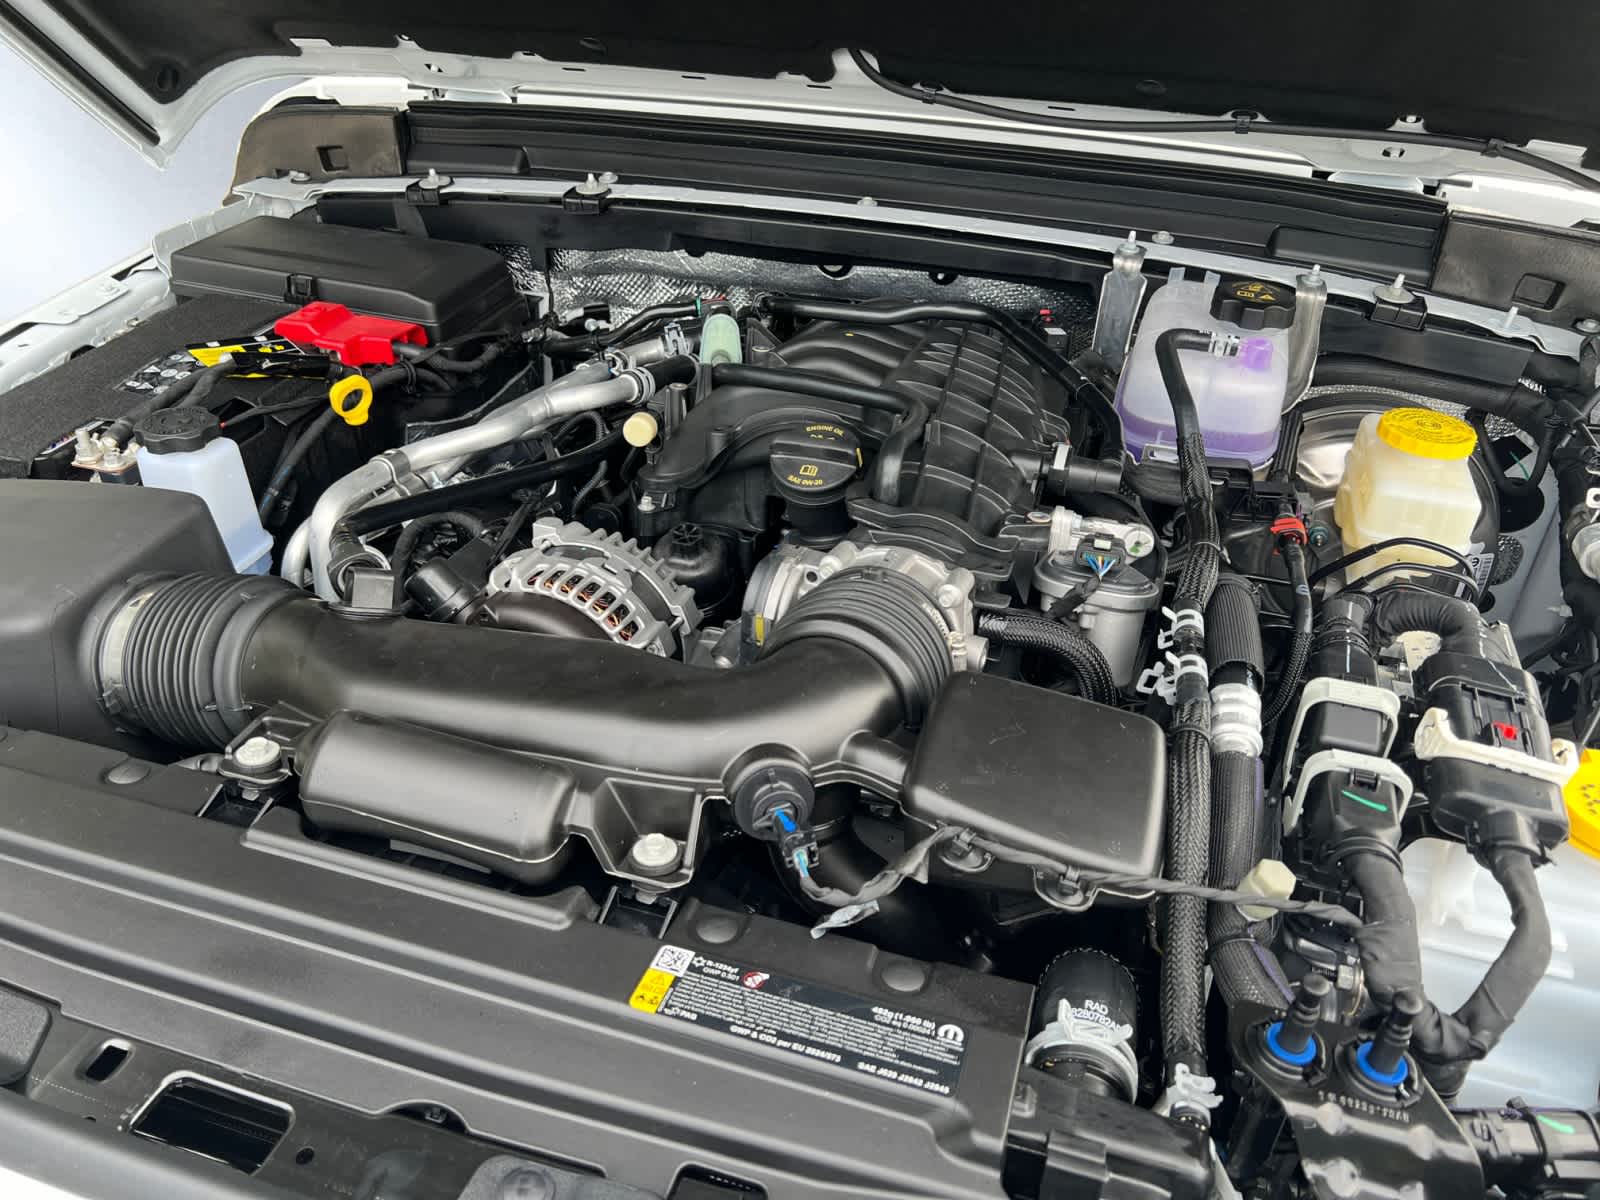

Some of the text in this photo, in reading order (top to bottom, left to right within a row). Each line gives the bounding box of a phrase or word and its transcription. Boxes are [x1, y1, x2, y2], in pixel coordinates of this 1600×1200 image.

[806, 424, 845, 437] ENGINE OIL
[787, 474, 801, 484] SAE
[1085, 999, 1109, 1015] RAD
